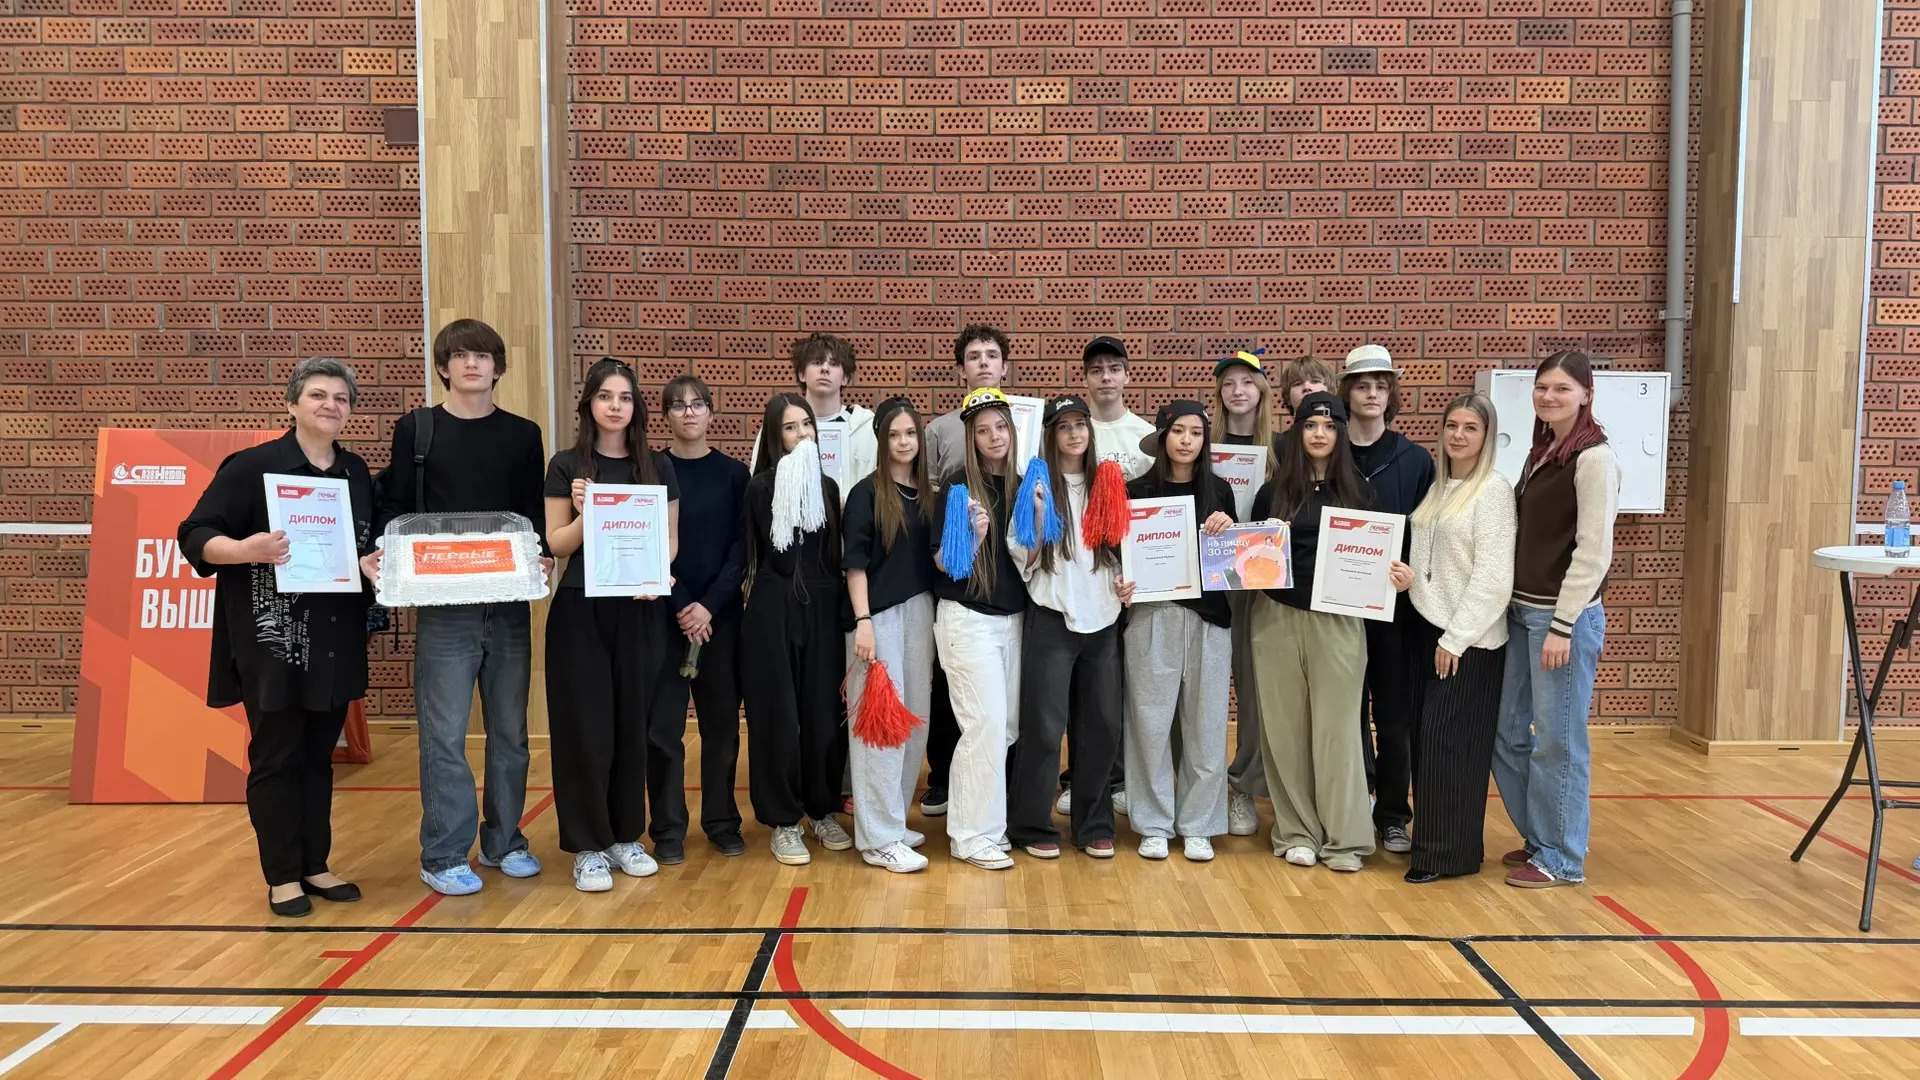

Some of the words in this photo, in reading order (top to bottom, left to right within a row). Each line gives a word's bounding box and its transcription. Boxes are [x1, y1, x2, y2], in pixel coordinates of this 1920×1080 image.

[1640, 382, 1648, 395] 3
[288, 514, 336, 525] ДИПЛОМ
[602, 520, 652, 531] ДИПЛОМ
[1136, 530, 1181, 543] ДИПЛОМ
[1207, 548, 1221, 556] 30
[1223, 548, 1236, 556] см
[1333, 543, 1384, 557] ДИПЛОМ
[136, 538, 217, 579] БУР
[250, 569, 259, 615] FANTASTIC
